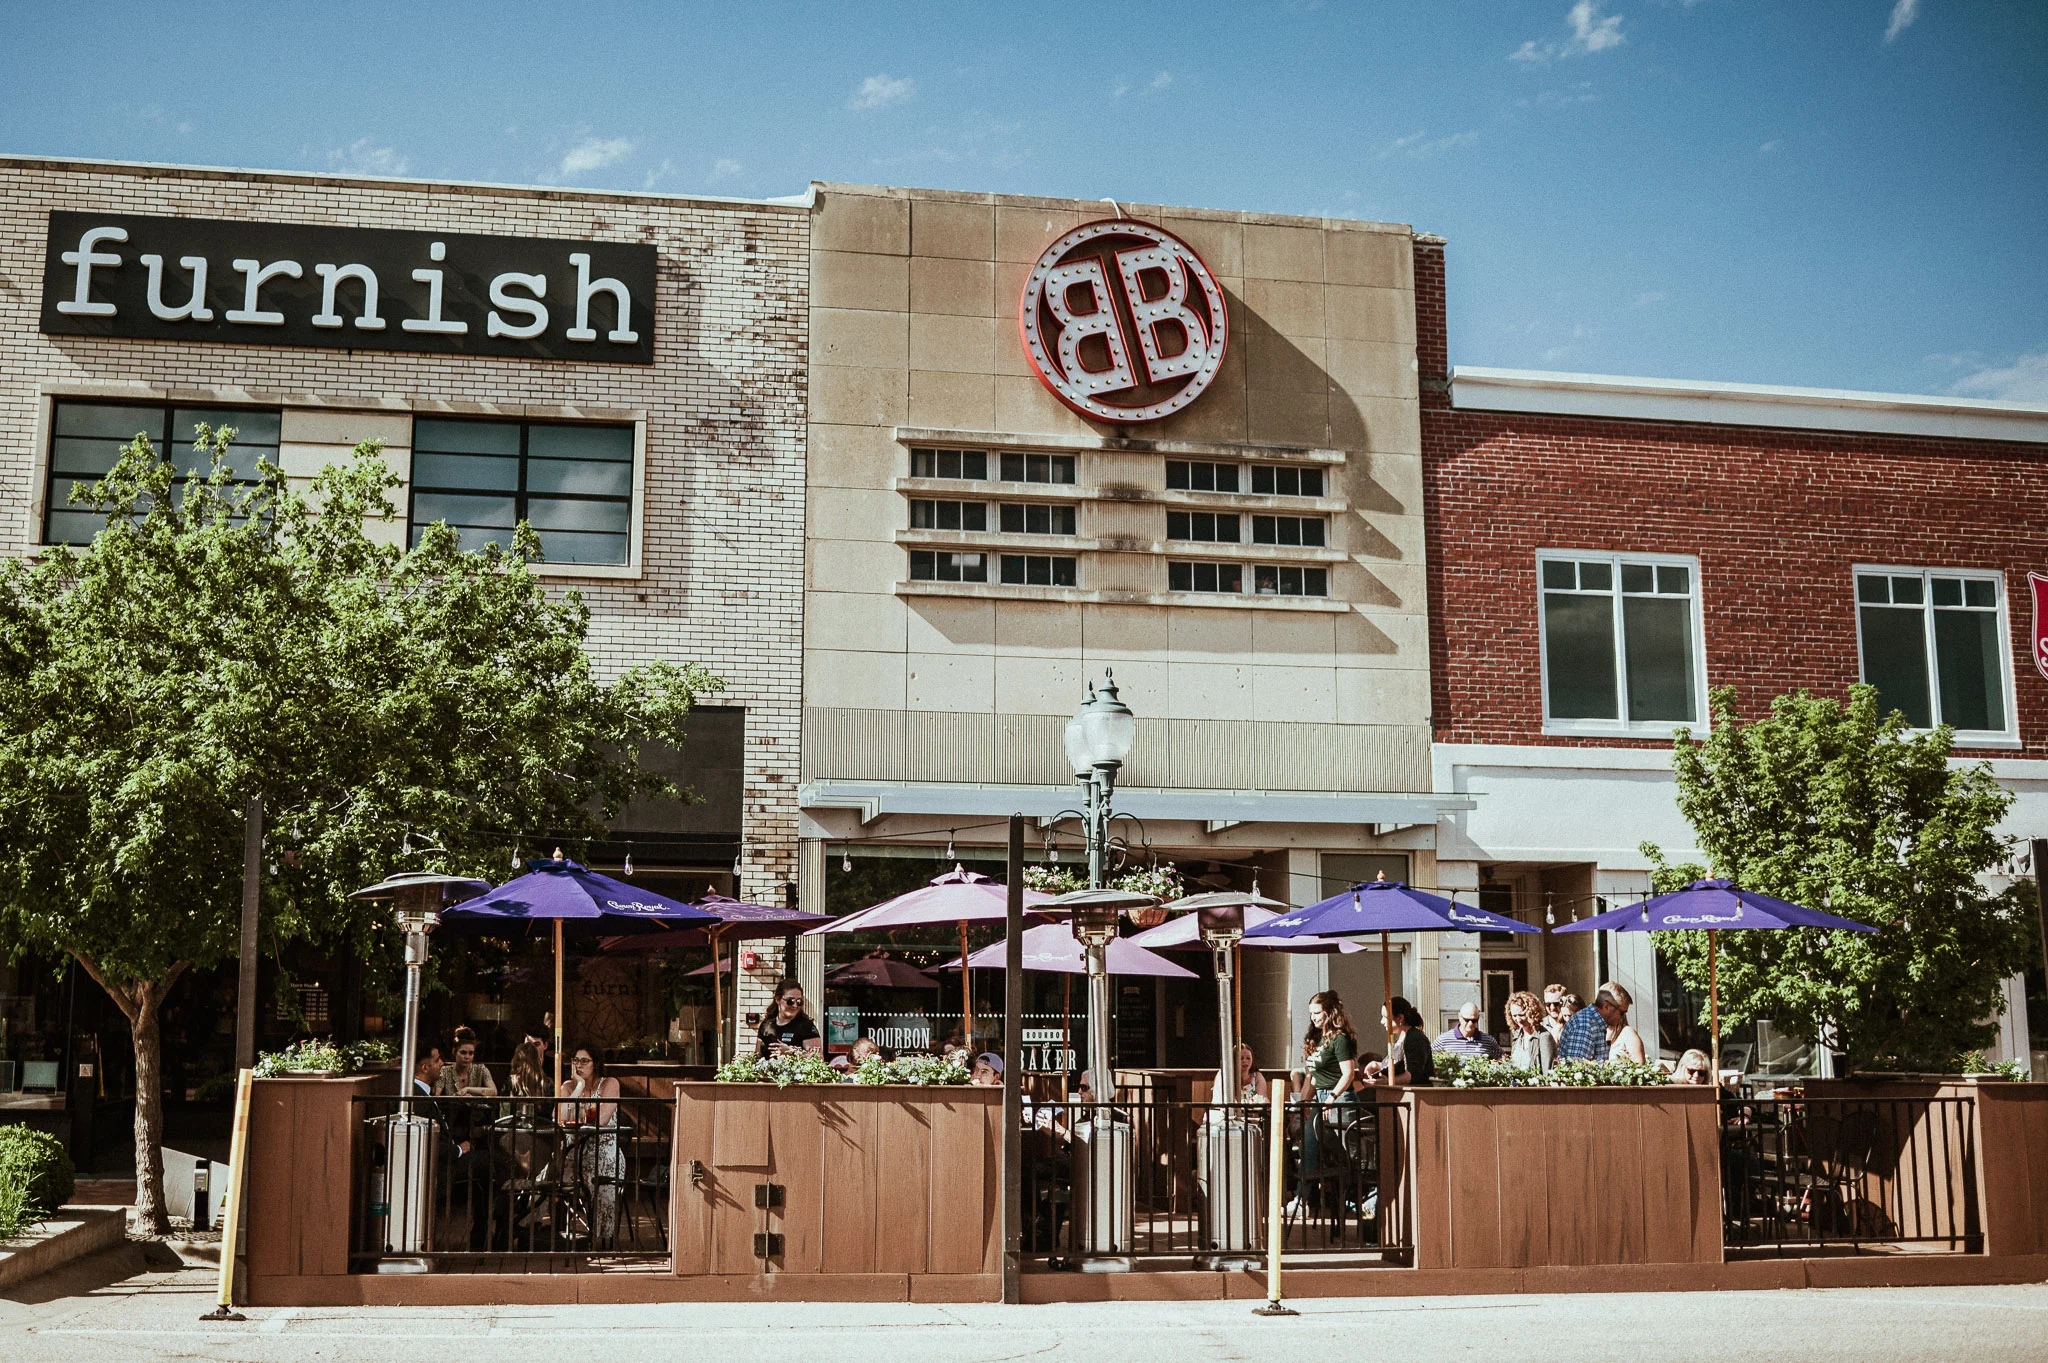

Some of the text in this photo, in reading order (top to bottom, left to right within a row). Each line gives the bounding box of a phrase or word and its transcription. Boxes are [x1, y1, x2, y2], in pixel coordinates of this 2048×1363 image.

[56, 226, 640, 344] furnish
[868, 1027, 930, 1049] BOURBON
[1026, 1031, 1064, 1039] BOURBO
